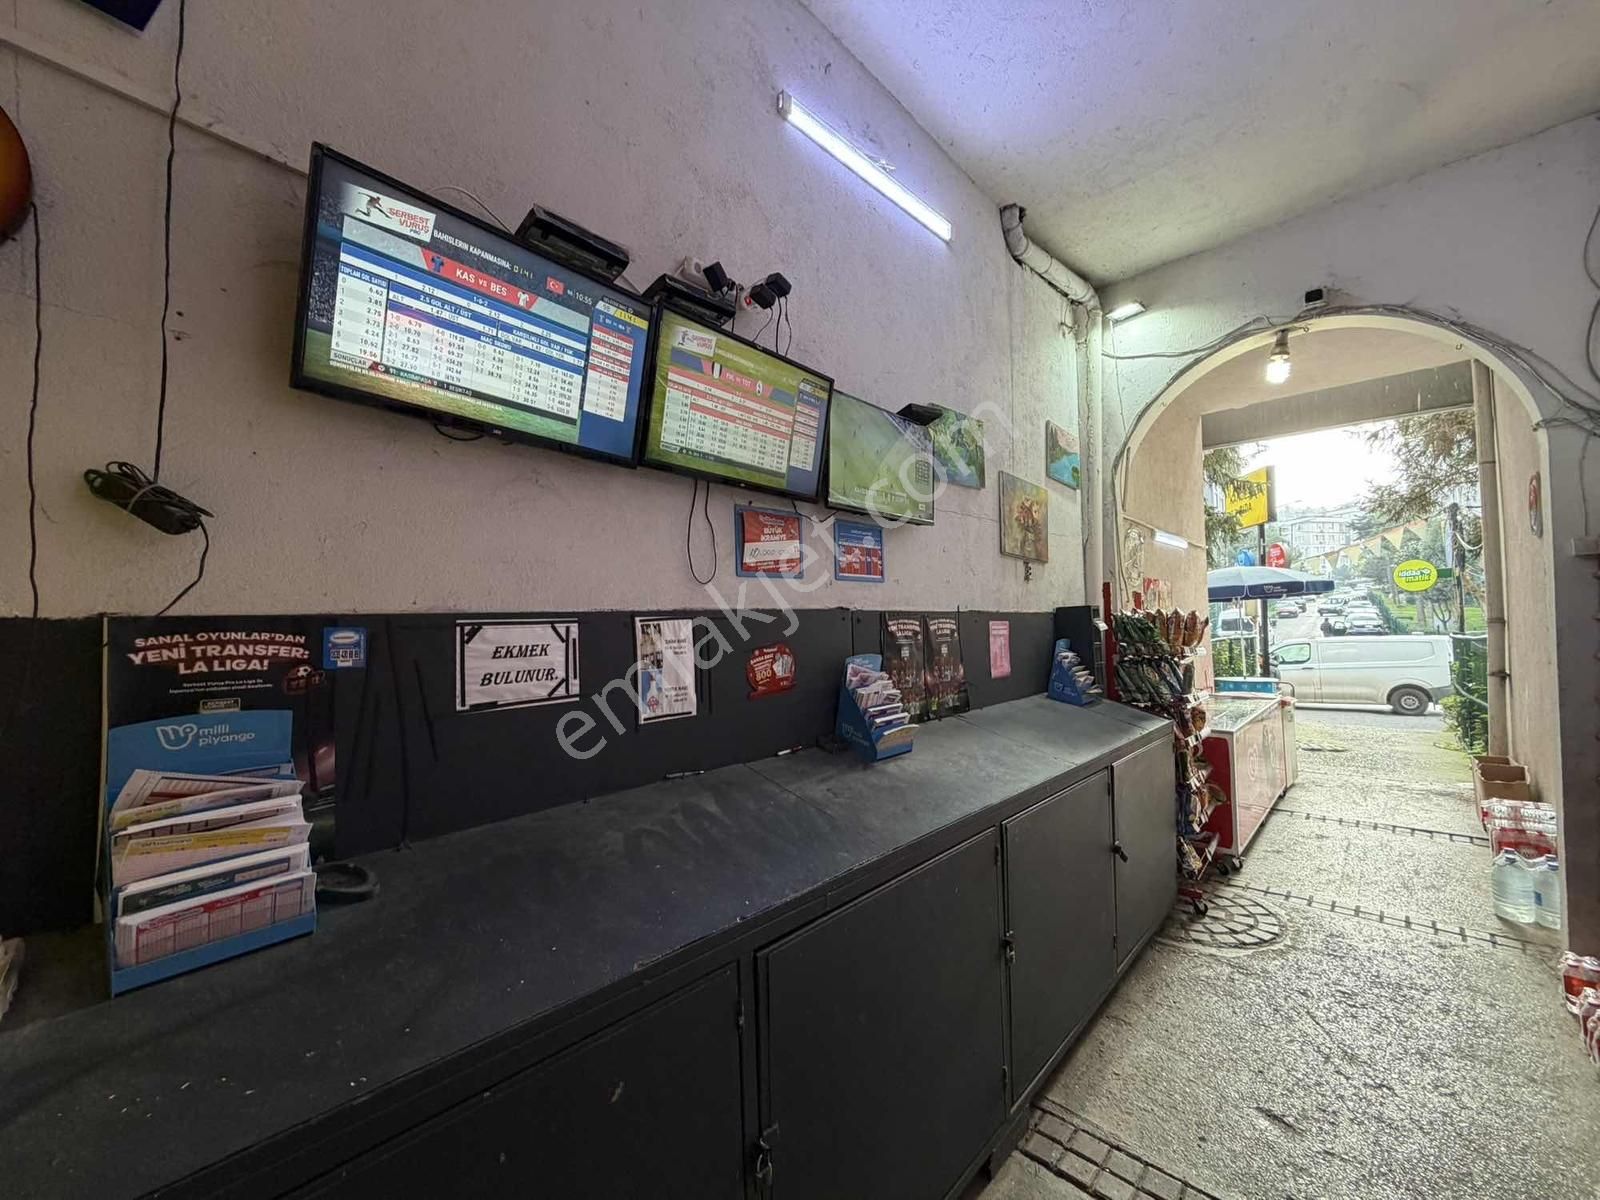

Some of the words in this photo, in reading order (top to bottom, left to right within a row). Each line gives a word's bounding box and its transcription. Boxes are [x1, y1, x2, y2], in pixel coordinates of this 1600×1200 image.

[388, 207, 430, 224] SERBEST
[422, 284, 434, 294] 2.12
[456, 268, 475, 284] KAS
[490, 282, 508, 296] BES
[430, 299, 442, 308] GOL
[444, 304, 456, 313] ALT
[576, 292, 592, 305] 10:55
[334, 352, 367, 366] SONUÇLAR
[134, 633, 194, 648] SANAL
[196, 632, 306, 644] OYUNLAR'DAN
[128, 644, 186, 666] YENİ
[491, 644, 551, 660] EKMEK
[178, 661, 210, 676] LA
[213, 659, 269, 672] LIGA!
[480, 668, 558, 686] BULUNUR.
[756, 670, 772, 682] 800
[200, 724, 230, 736] milli
[199, 732, 256, 747] piyango
